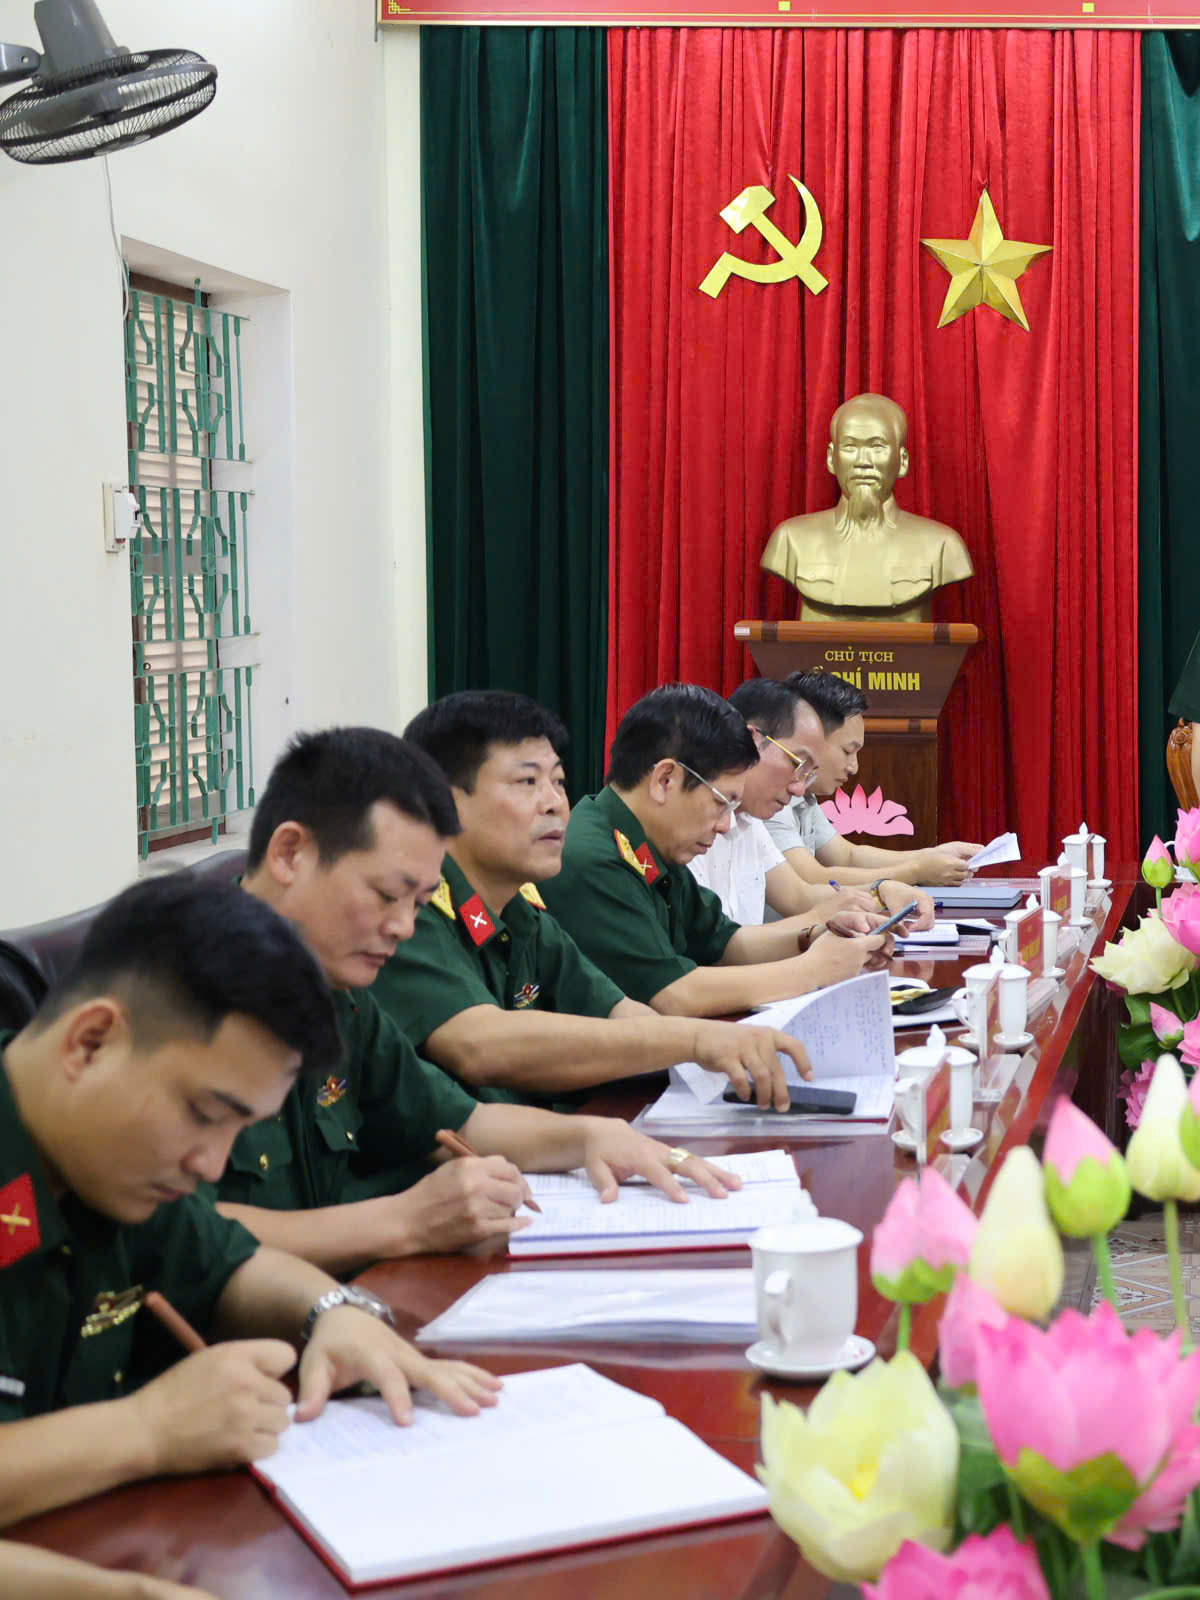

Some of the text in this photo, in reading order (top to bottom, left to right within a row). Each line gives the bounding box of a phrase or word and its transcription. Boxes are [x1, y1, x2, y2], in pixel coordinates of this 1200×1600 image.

[824, 645, 894, 664] CHỦ TỊCH
[868, 671, 920, 690] MINH
